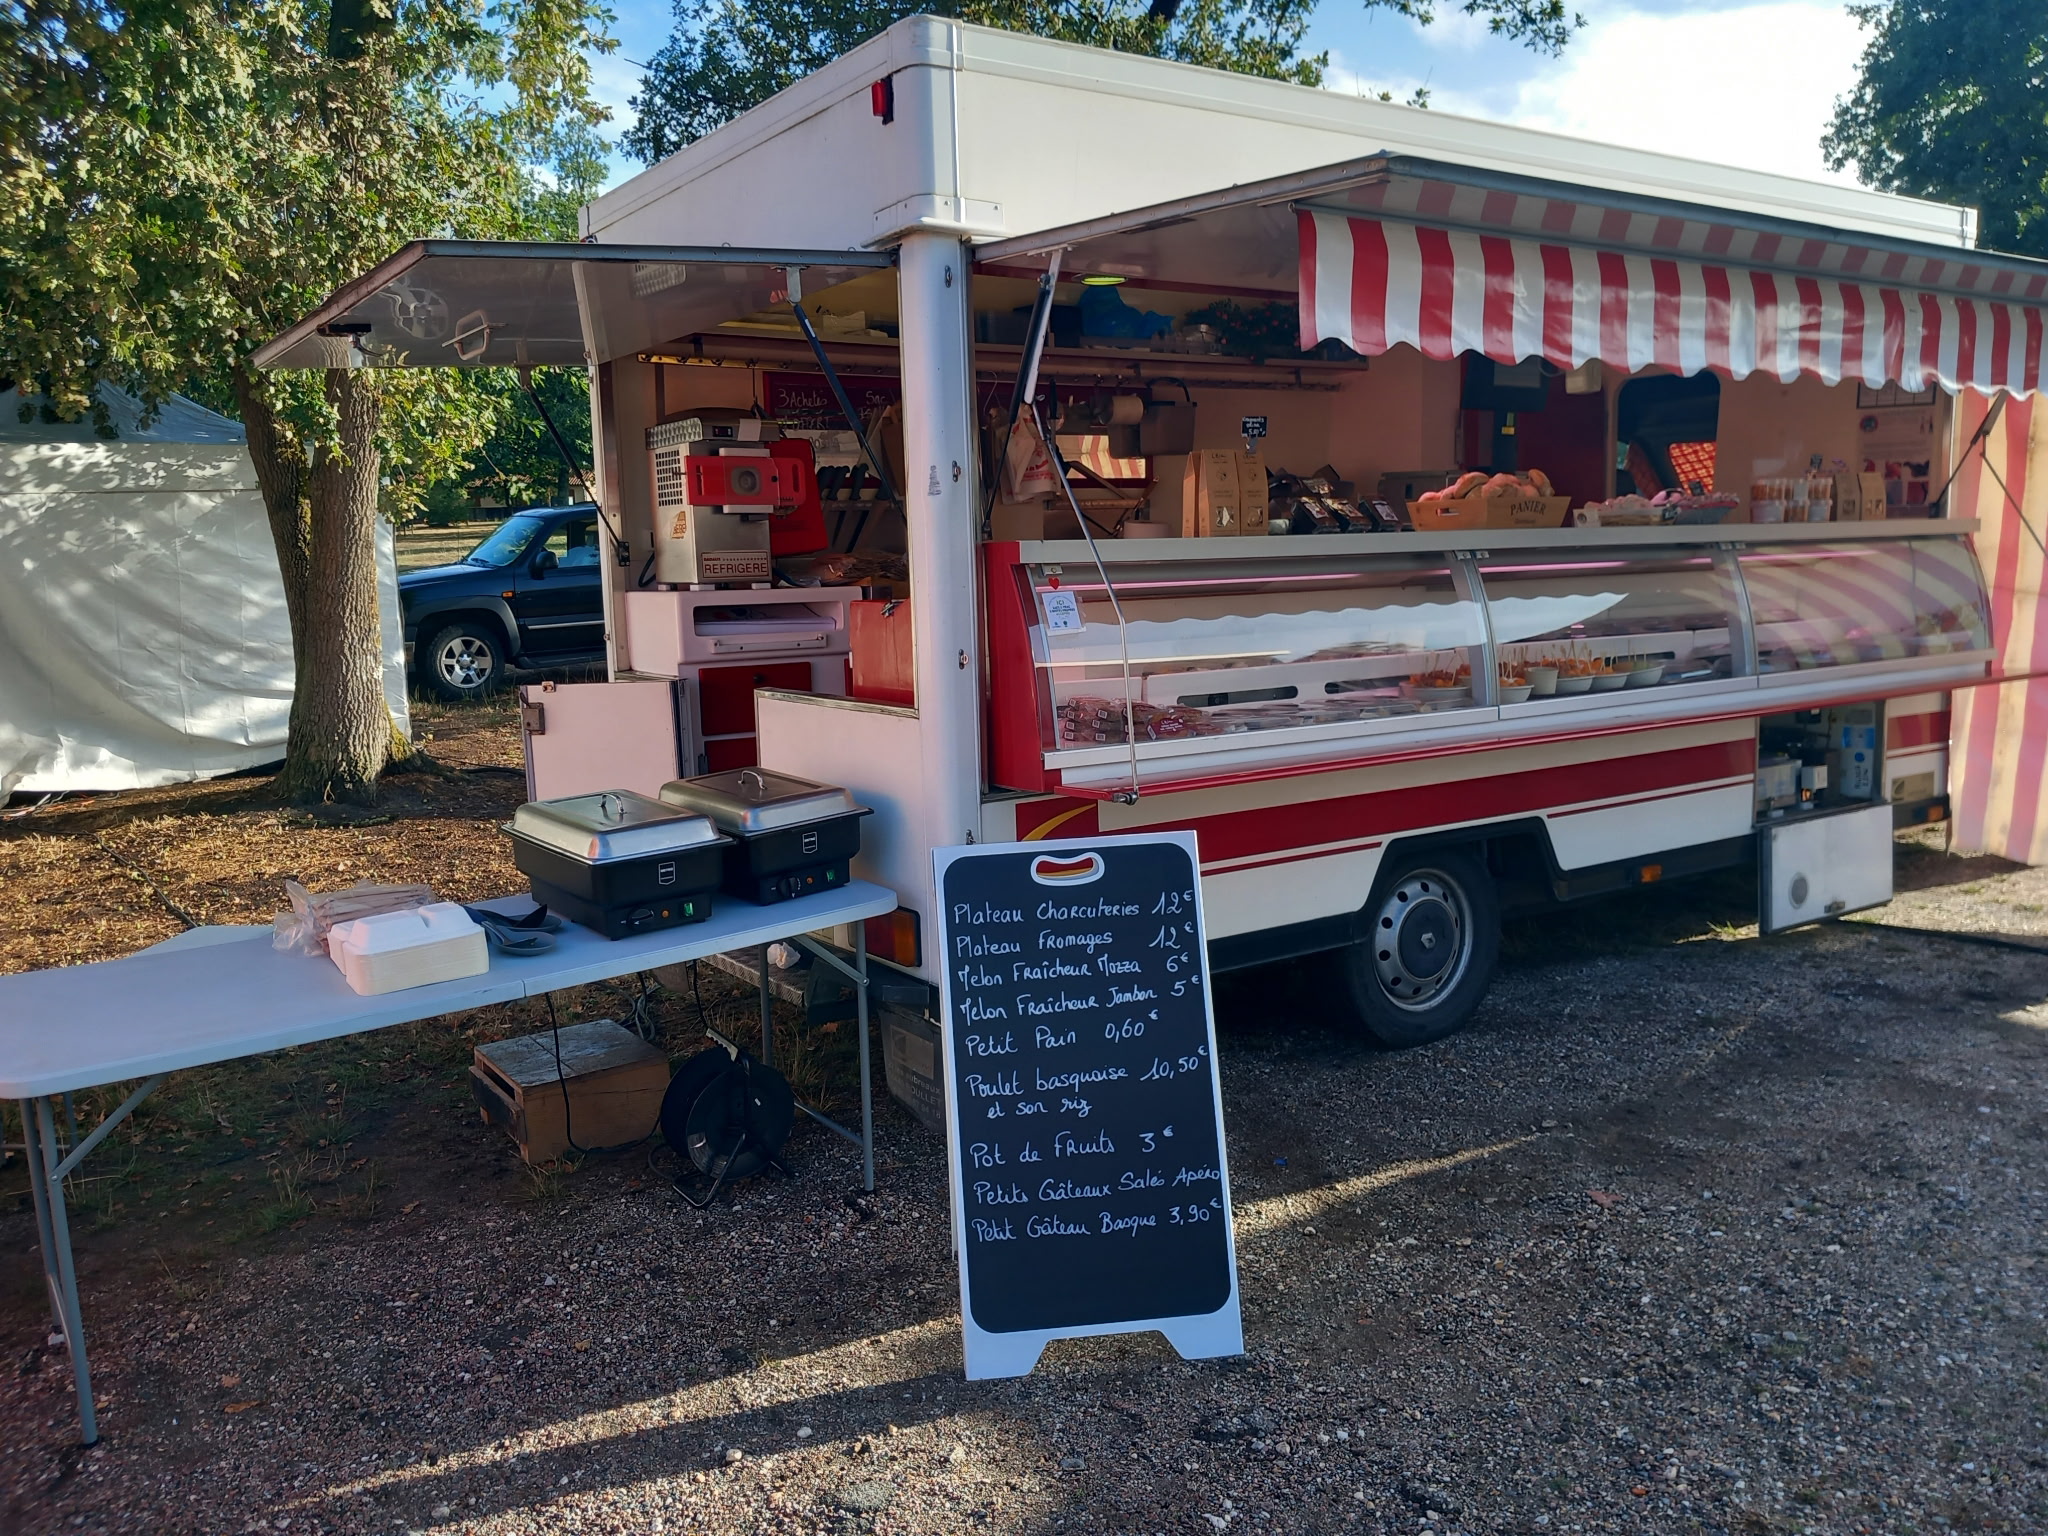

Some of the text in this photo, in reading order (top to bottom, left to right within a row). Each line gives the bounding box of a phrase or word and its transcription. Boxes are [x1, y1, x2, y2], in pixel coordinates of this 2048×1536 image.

[1510, 500, 1547, 517] PANIER
[704, 562, 768, 574] REFRIGERE
[954, 902, 1024, 924] Plateau
[957, 934, 1021, 957] Plateau
[1038, 929, 1113, 954] Fromages
[1105, 984, 1158, 1008] Jambon
[965, 1030, 1018, 1056] Petit
[1036, 1025, 1077, 1049] Pain
[964, 1070, 1025, 1098] Poulet
[1036, 1064, 1129, 1093] basquaise
[986, 1096, 1093, 1120] et son riz
[969, 1142, 1006, 1169] Pot
[1019, 1141, 1043, 1163] de
[1054, 1128, 1115, 1158] Fruits
[973, 1180, 1029, 1205] Petits
[1038, 1178, 1112, 1201] Gâteaux
[971, 1217, 1017, 1243] Petit
[1026, 1214, 1092, 1238] Gâteau
[1099, 1211, 1157, 1238] Basque
